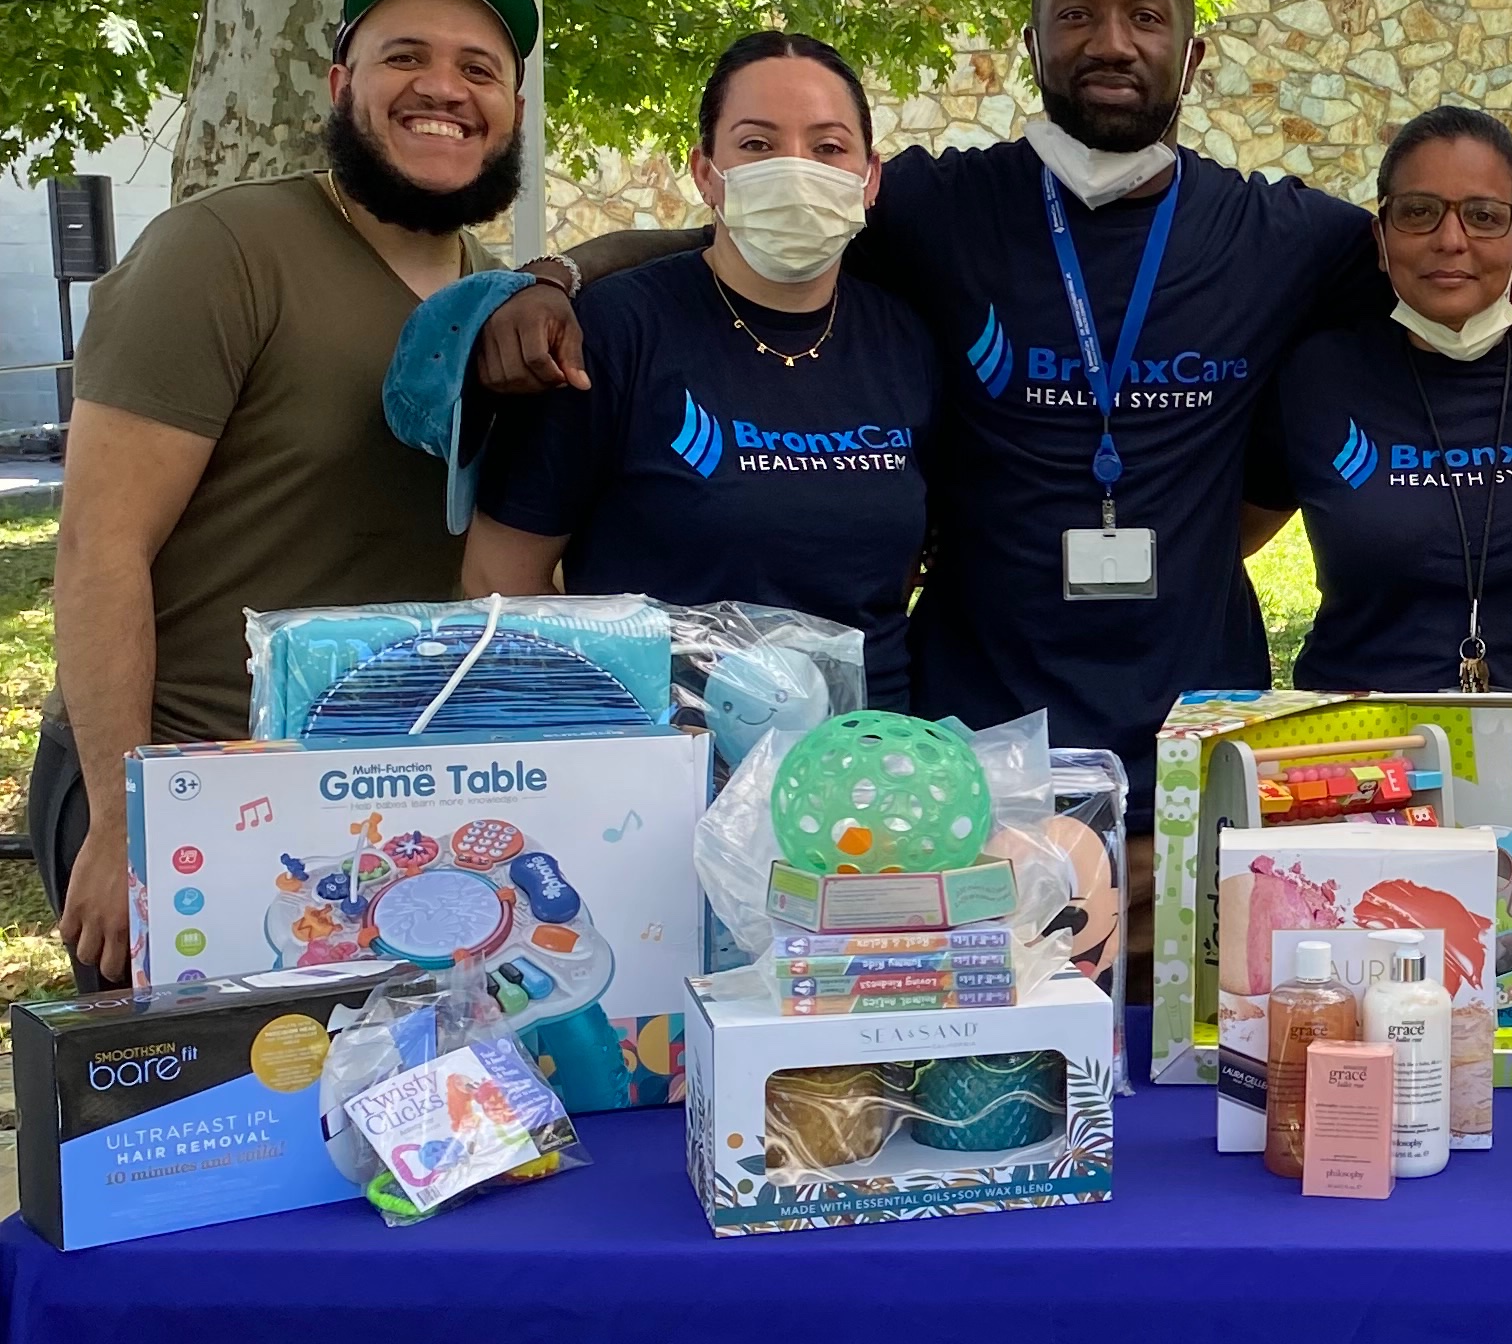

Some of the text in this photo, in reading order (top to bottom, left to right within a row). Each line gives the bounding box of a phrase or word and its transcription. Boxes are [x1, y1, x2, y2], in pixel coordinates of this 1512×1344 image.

[1028, 347, 1248, 384] BrnxCare
[1131, 391, 1213, 408] SYSTEM
[733, 420, 912, 452] BronxCa
[739, 454, 906, 472] HEALTH SYSTEM
[1390, 473, 1483, 487] HEALTH
[319, 761, 548, 802] Game Table
[352, 762, 432, 776] Multi-Function
[860, 1027, 903, 1044] SEA
[918, 1023, 976, 1040] SAND
[1290, 1025, 1328, 1041] grace
[1388, 1024, 1425, 1041] grace
[94, 1042, 176, 1064] SMOOTHSKIN
[88, 1045, 198, 1090] bare fit
[1329, 1070, 1367, 1085] grace
[351, 1069, 439, 1118] Twisty
[365, 1092, 445, 1136] Clicks
[106, 1109, 280, 1151] ULTRAFAST IPL
[117, 1129, 270, 1166] HAIR REMOVAL
[105, 1171, 126, 1185] 10
[131, 1159, 197, 1182] minutes
[201, 1155, 232, 1170] and
[1326, 1169, 1364, 1180] philosophy
[780, 1204, 816, 1216] MADE
[820, 1202, 851, 1213] WITH
[855, 1194, 920, 1211] ESSENTIAL
[984, 1187, 1011, 1197] WAX
[1015, 1182, 1054, 1195] BLEND
